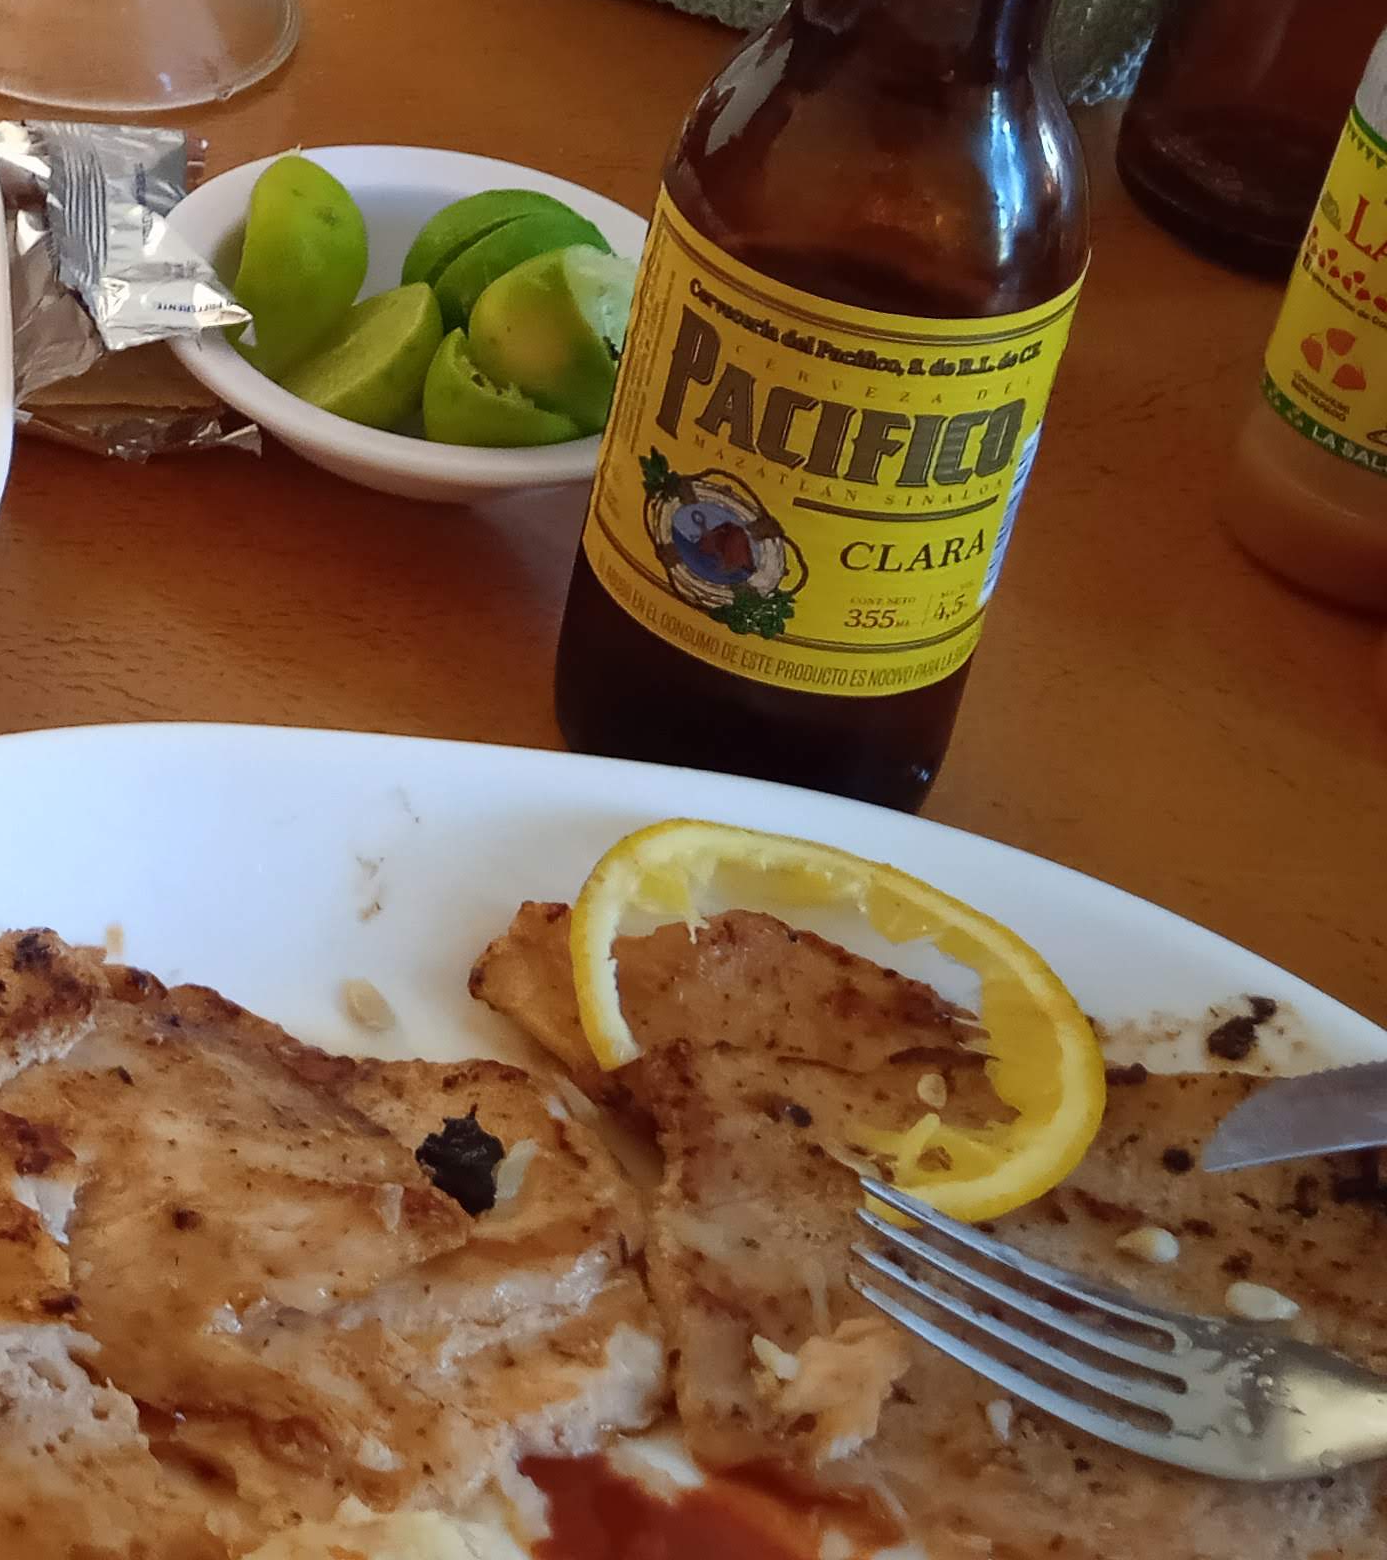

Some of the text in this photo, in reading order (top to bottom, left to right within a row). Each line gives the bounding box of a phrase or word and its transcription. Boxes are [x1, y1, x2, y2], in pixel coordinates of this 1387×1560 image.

[656, 303, 1026, 488] PACIFICO
[735, 344, 943, 404] CERVEZA
[839, 528, 985, 572] CLARA
[844, 609, 896, 628] 355
[659, 611, 721, 656] CONSUMO
[721, 643, 740, 665] DE
[740, 649, 777, 675] ESTE
[777, 659, 848, 687] PRODUCTO
[849, 669, 868, 687] ES
